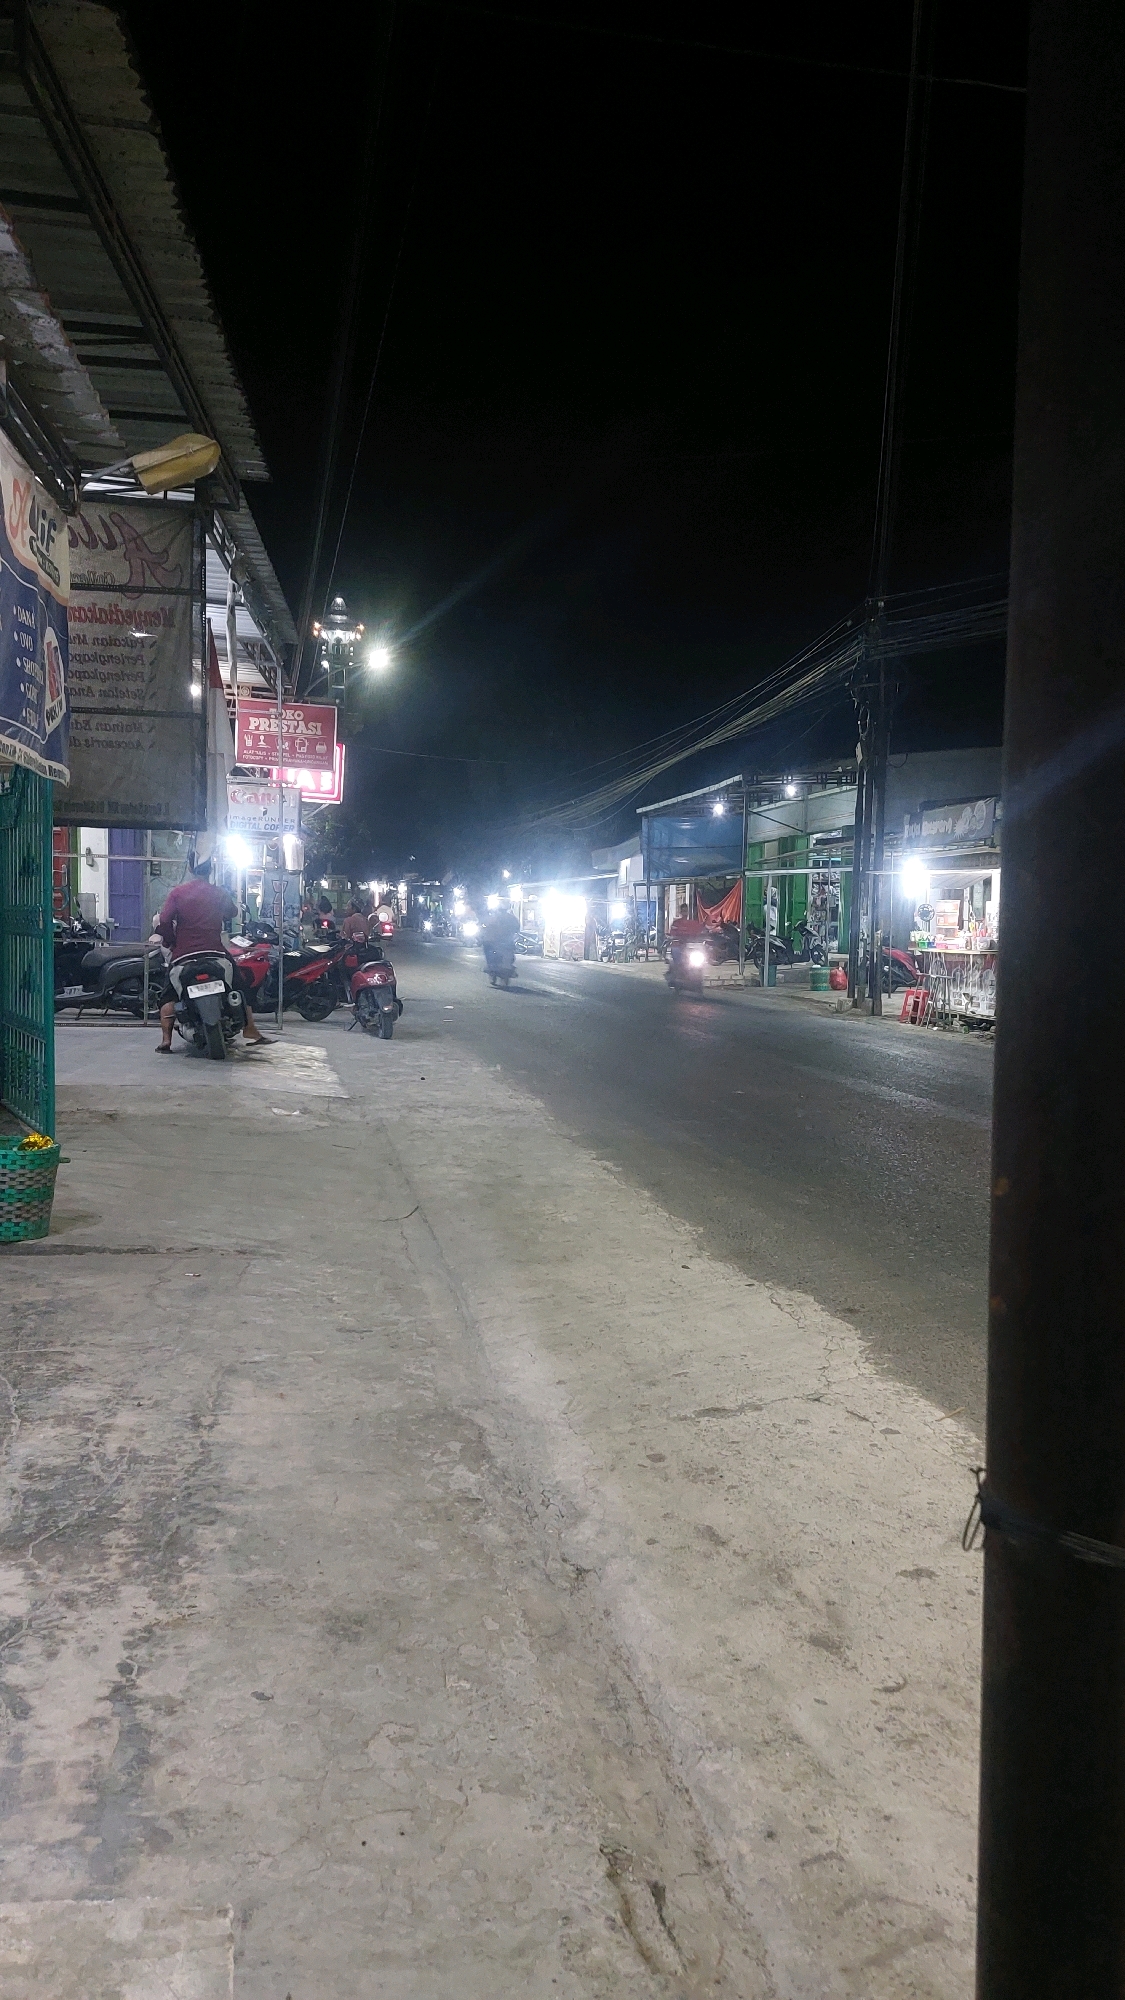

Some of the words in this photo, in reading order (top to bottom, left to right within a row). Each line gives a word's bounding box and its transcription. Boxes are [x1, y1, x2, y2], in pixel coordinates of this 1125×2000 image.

[269, 708, 304, 721] TOKO
[248, 717, 322, 736] PRESTASI
[230, 815, 296, 824] imageRUNER
[230, 820, 262, 830] DIGITAL
